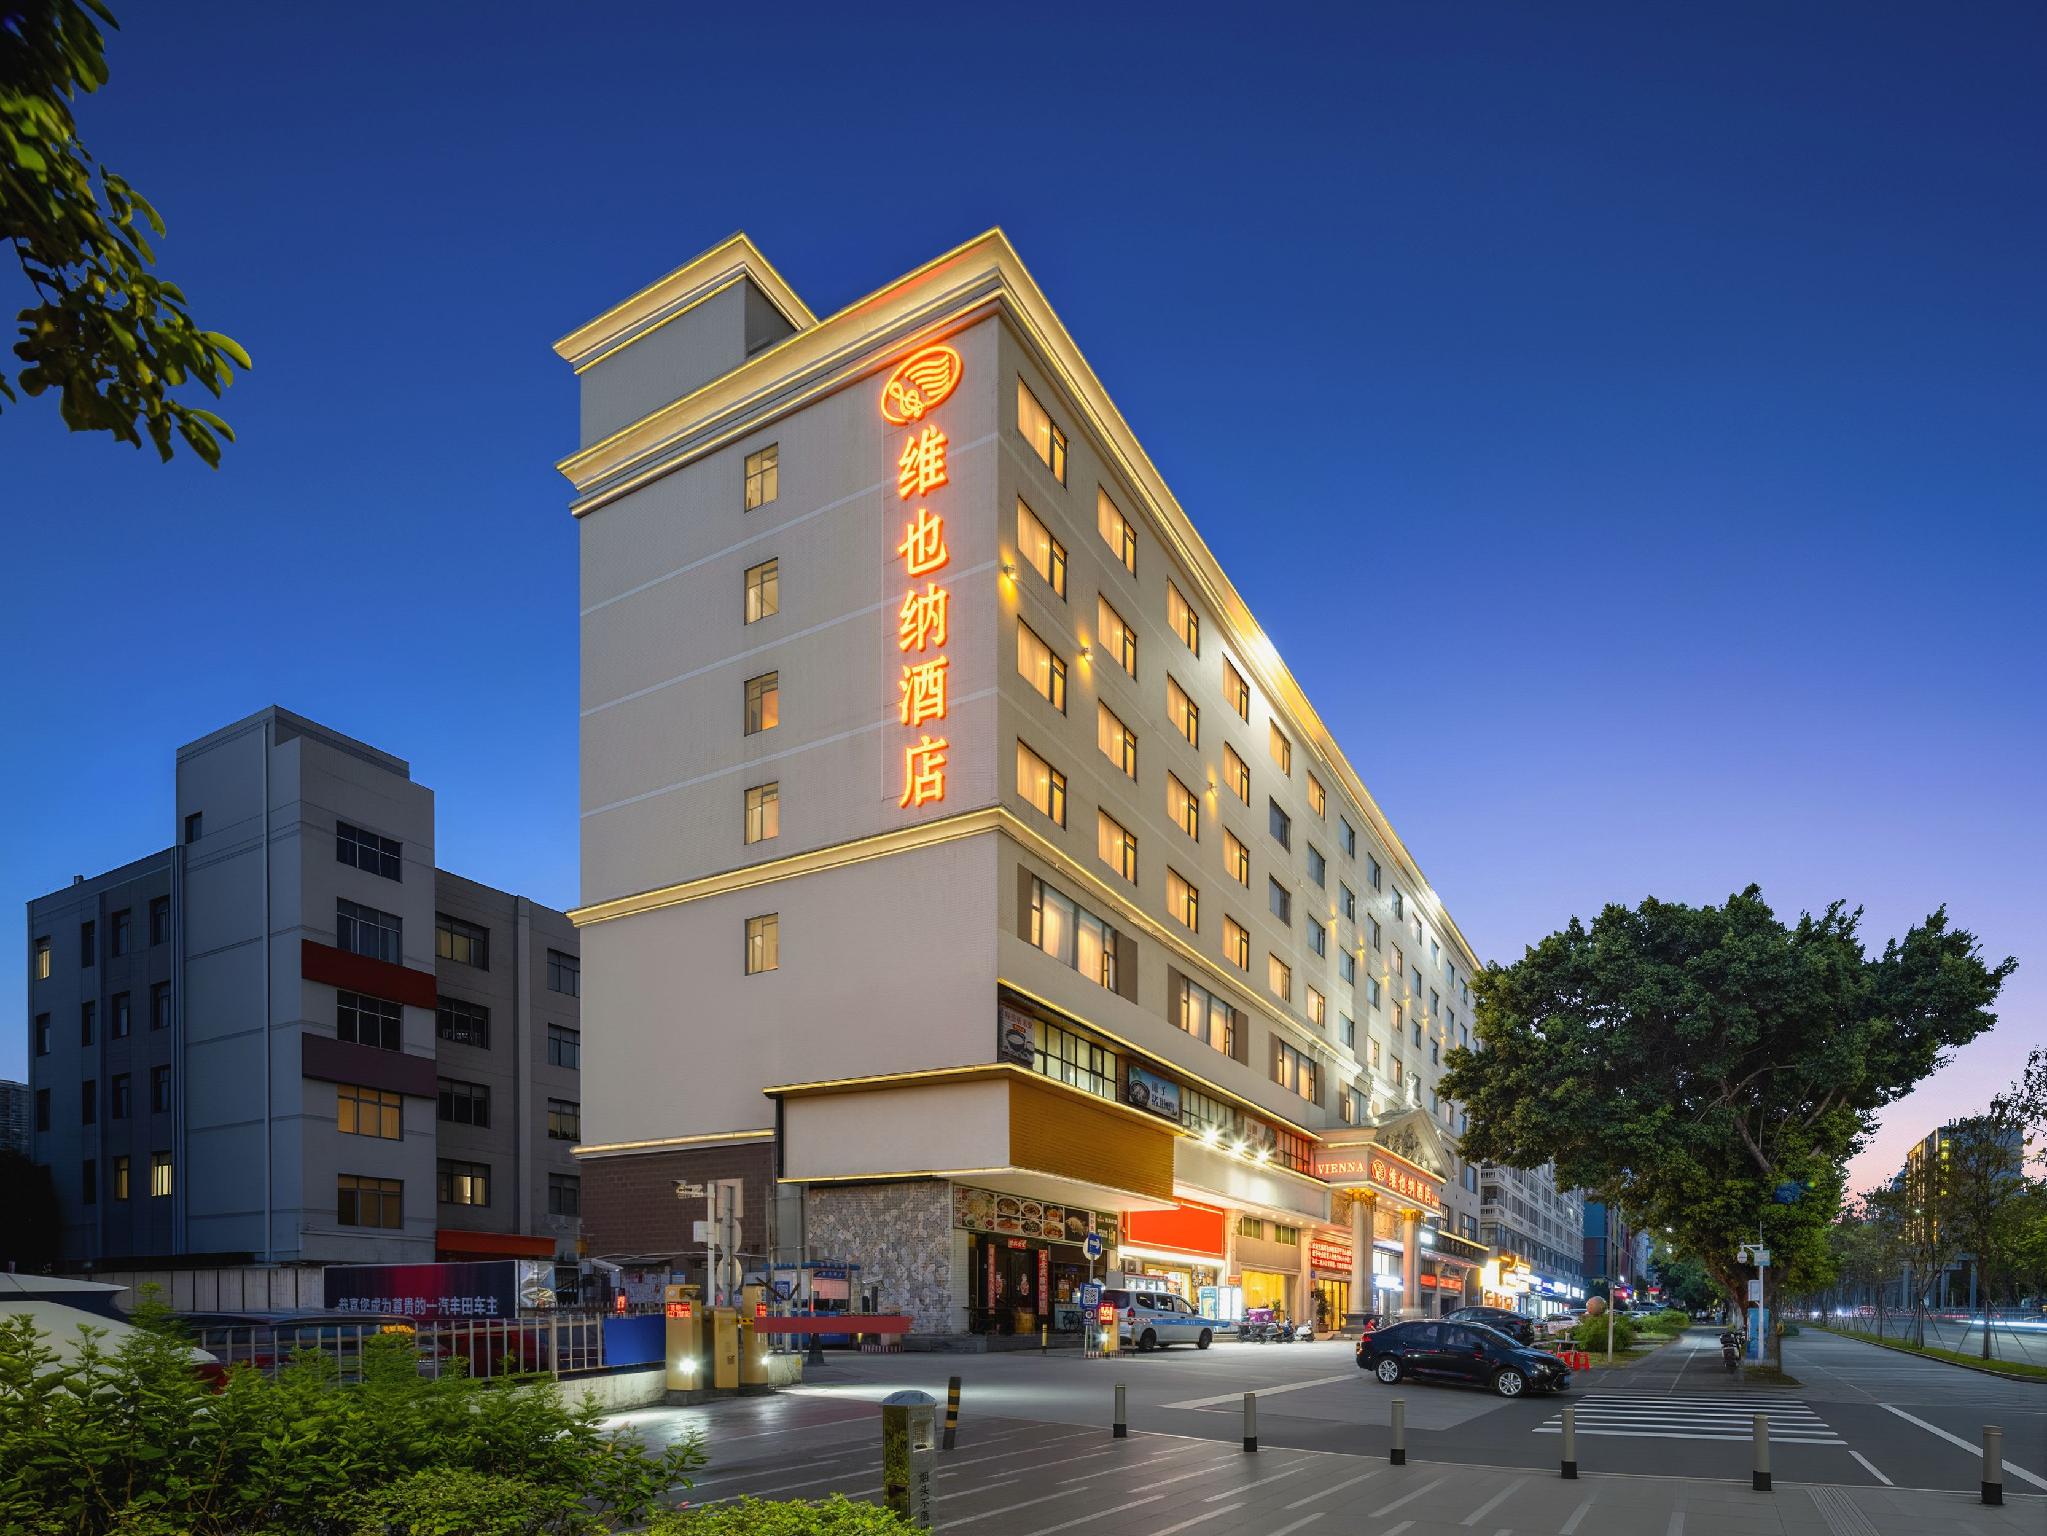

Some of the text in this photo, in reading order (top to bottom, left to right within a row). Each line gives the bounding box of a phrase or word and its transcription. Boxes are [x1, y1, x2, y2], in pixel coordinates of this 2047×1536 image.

[897, 424, 949, 808] 维也纳酒店
[1318, 1161, 1364, 1174] VIENNA
[1388, 1166, 1432, 1205] 维也纳酒店
